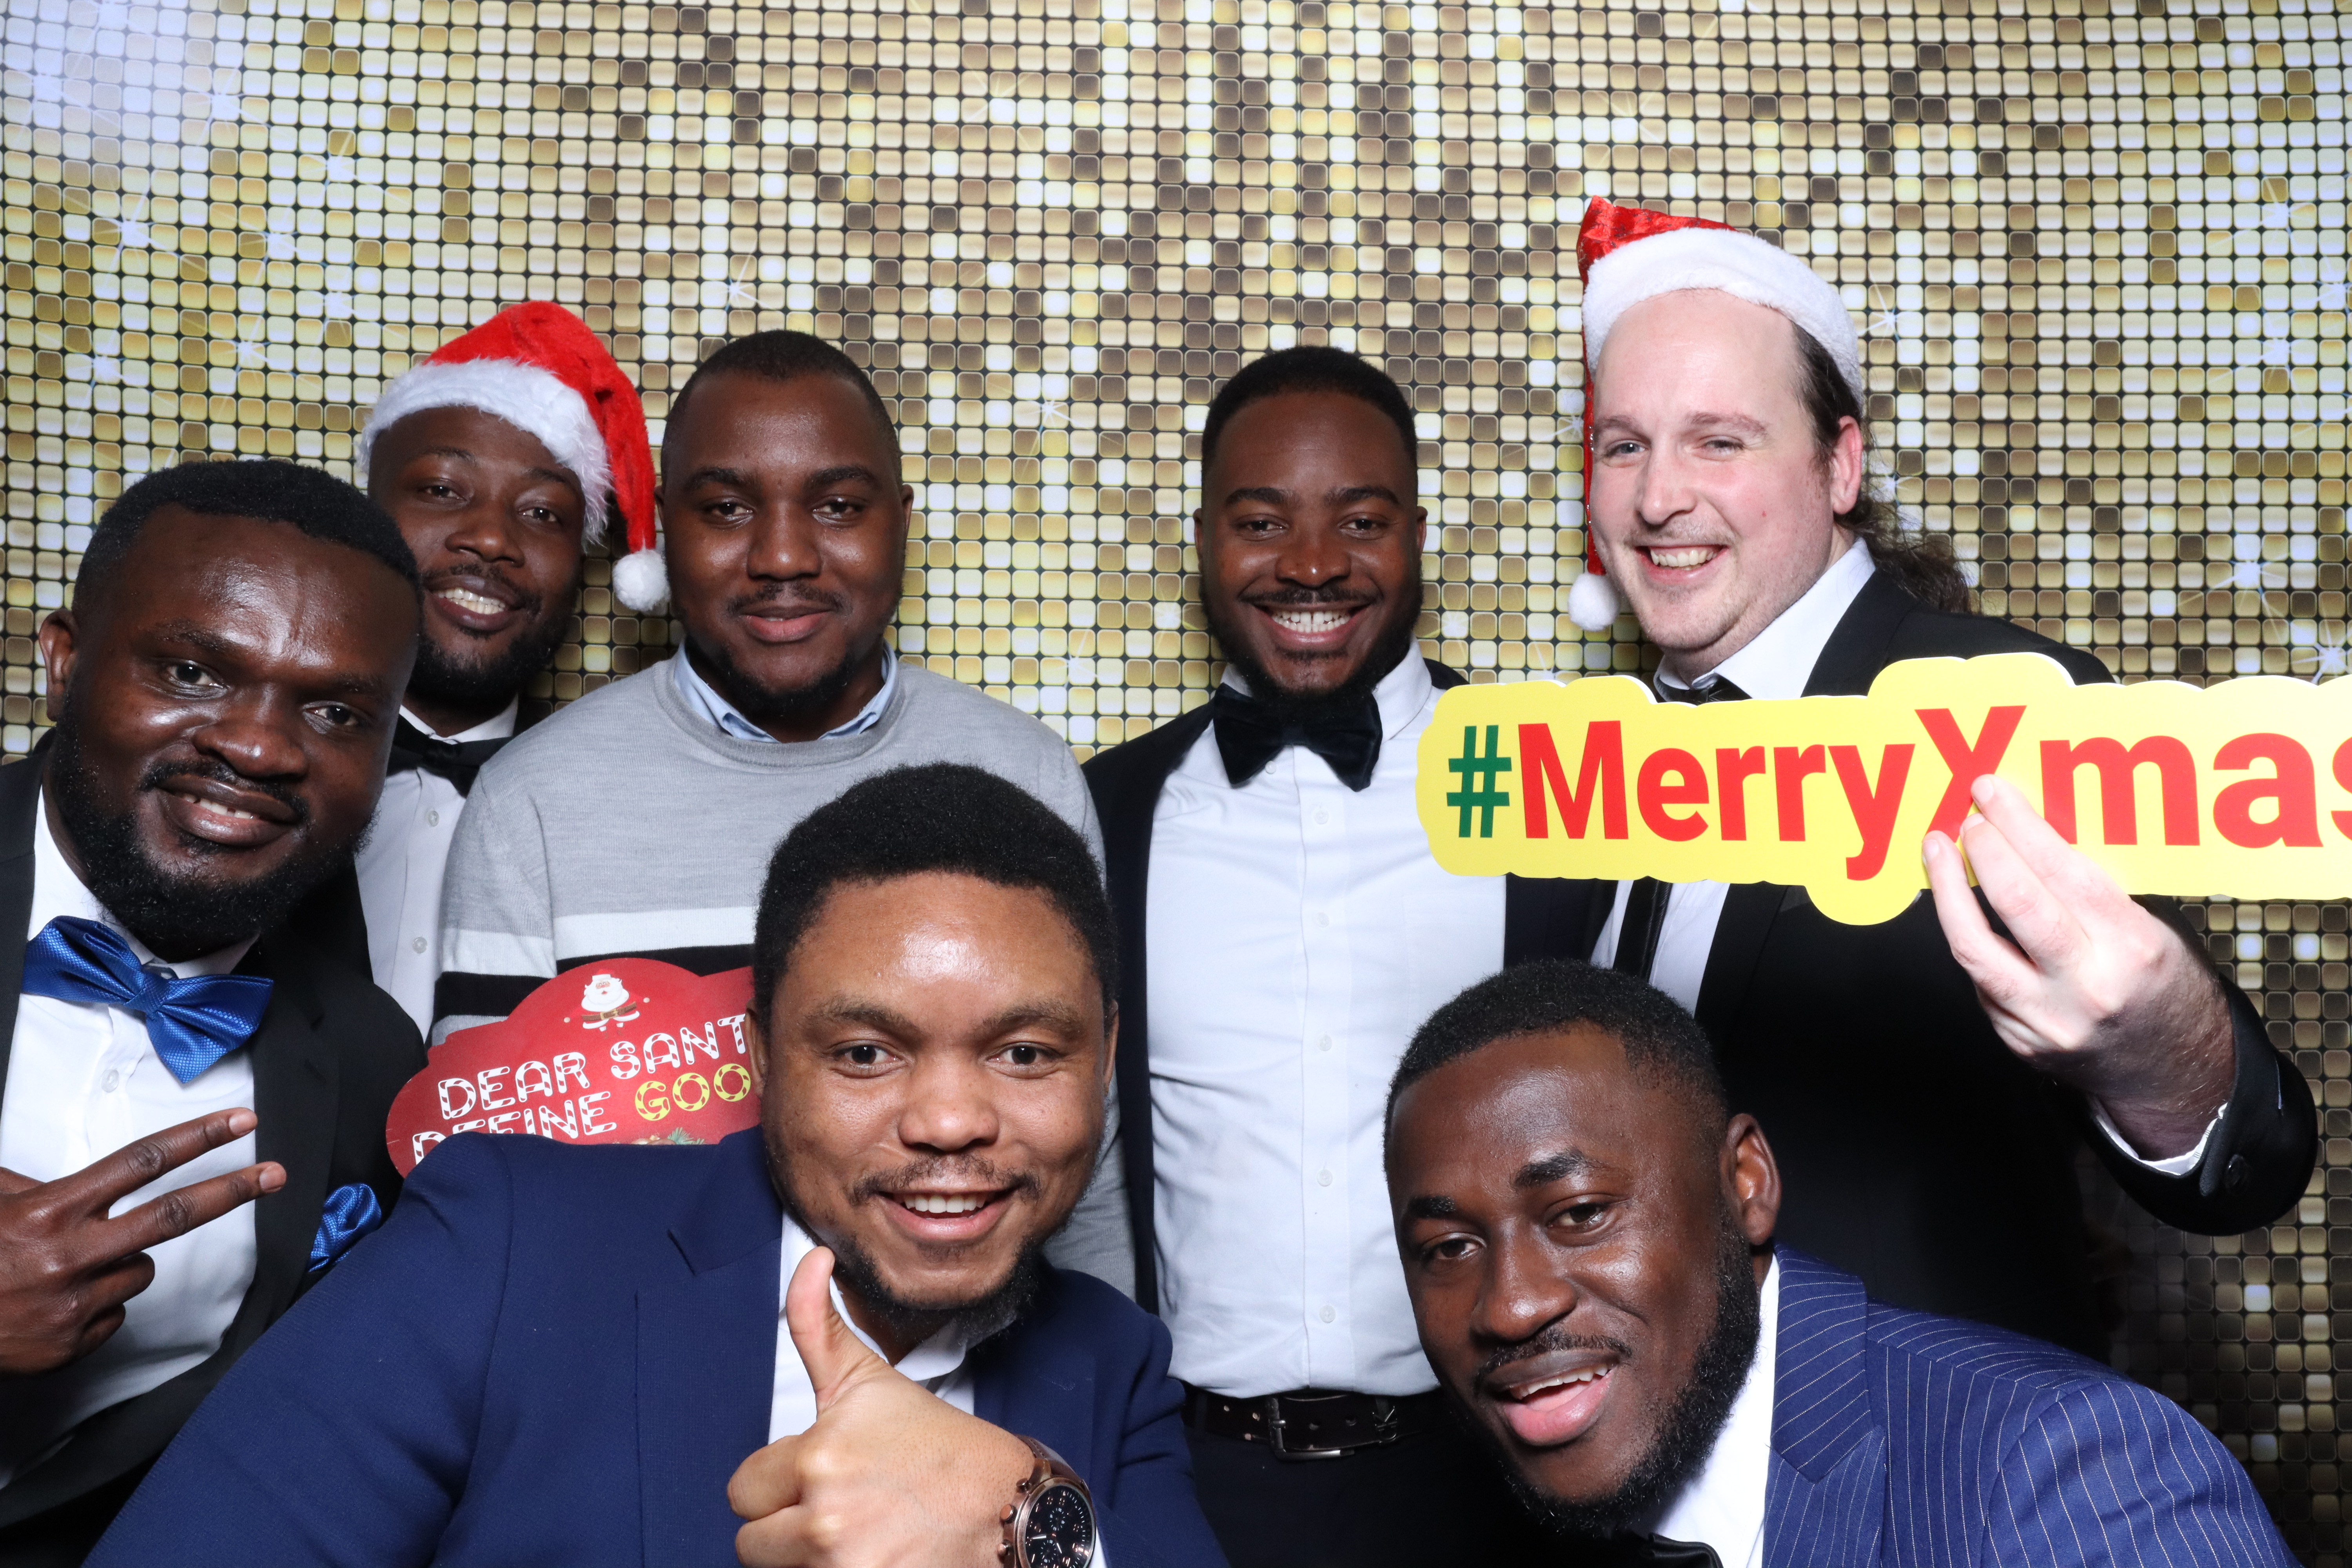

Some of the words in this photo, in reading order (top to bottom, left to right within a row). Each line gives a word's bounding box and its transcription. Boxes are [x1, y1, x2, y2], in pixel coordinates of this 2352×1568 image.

[1446, 705, 2352, 881] #MerryXma
[437, 1052, 590, 1120] DEAR
[610, 1013, 746, 1079] SANT
[635, 1063, 751, 1121] GOO
